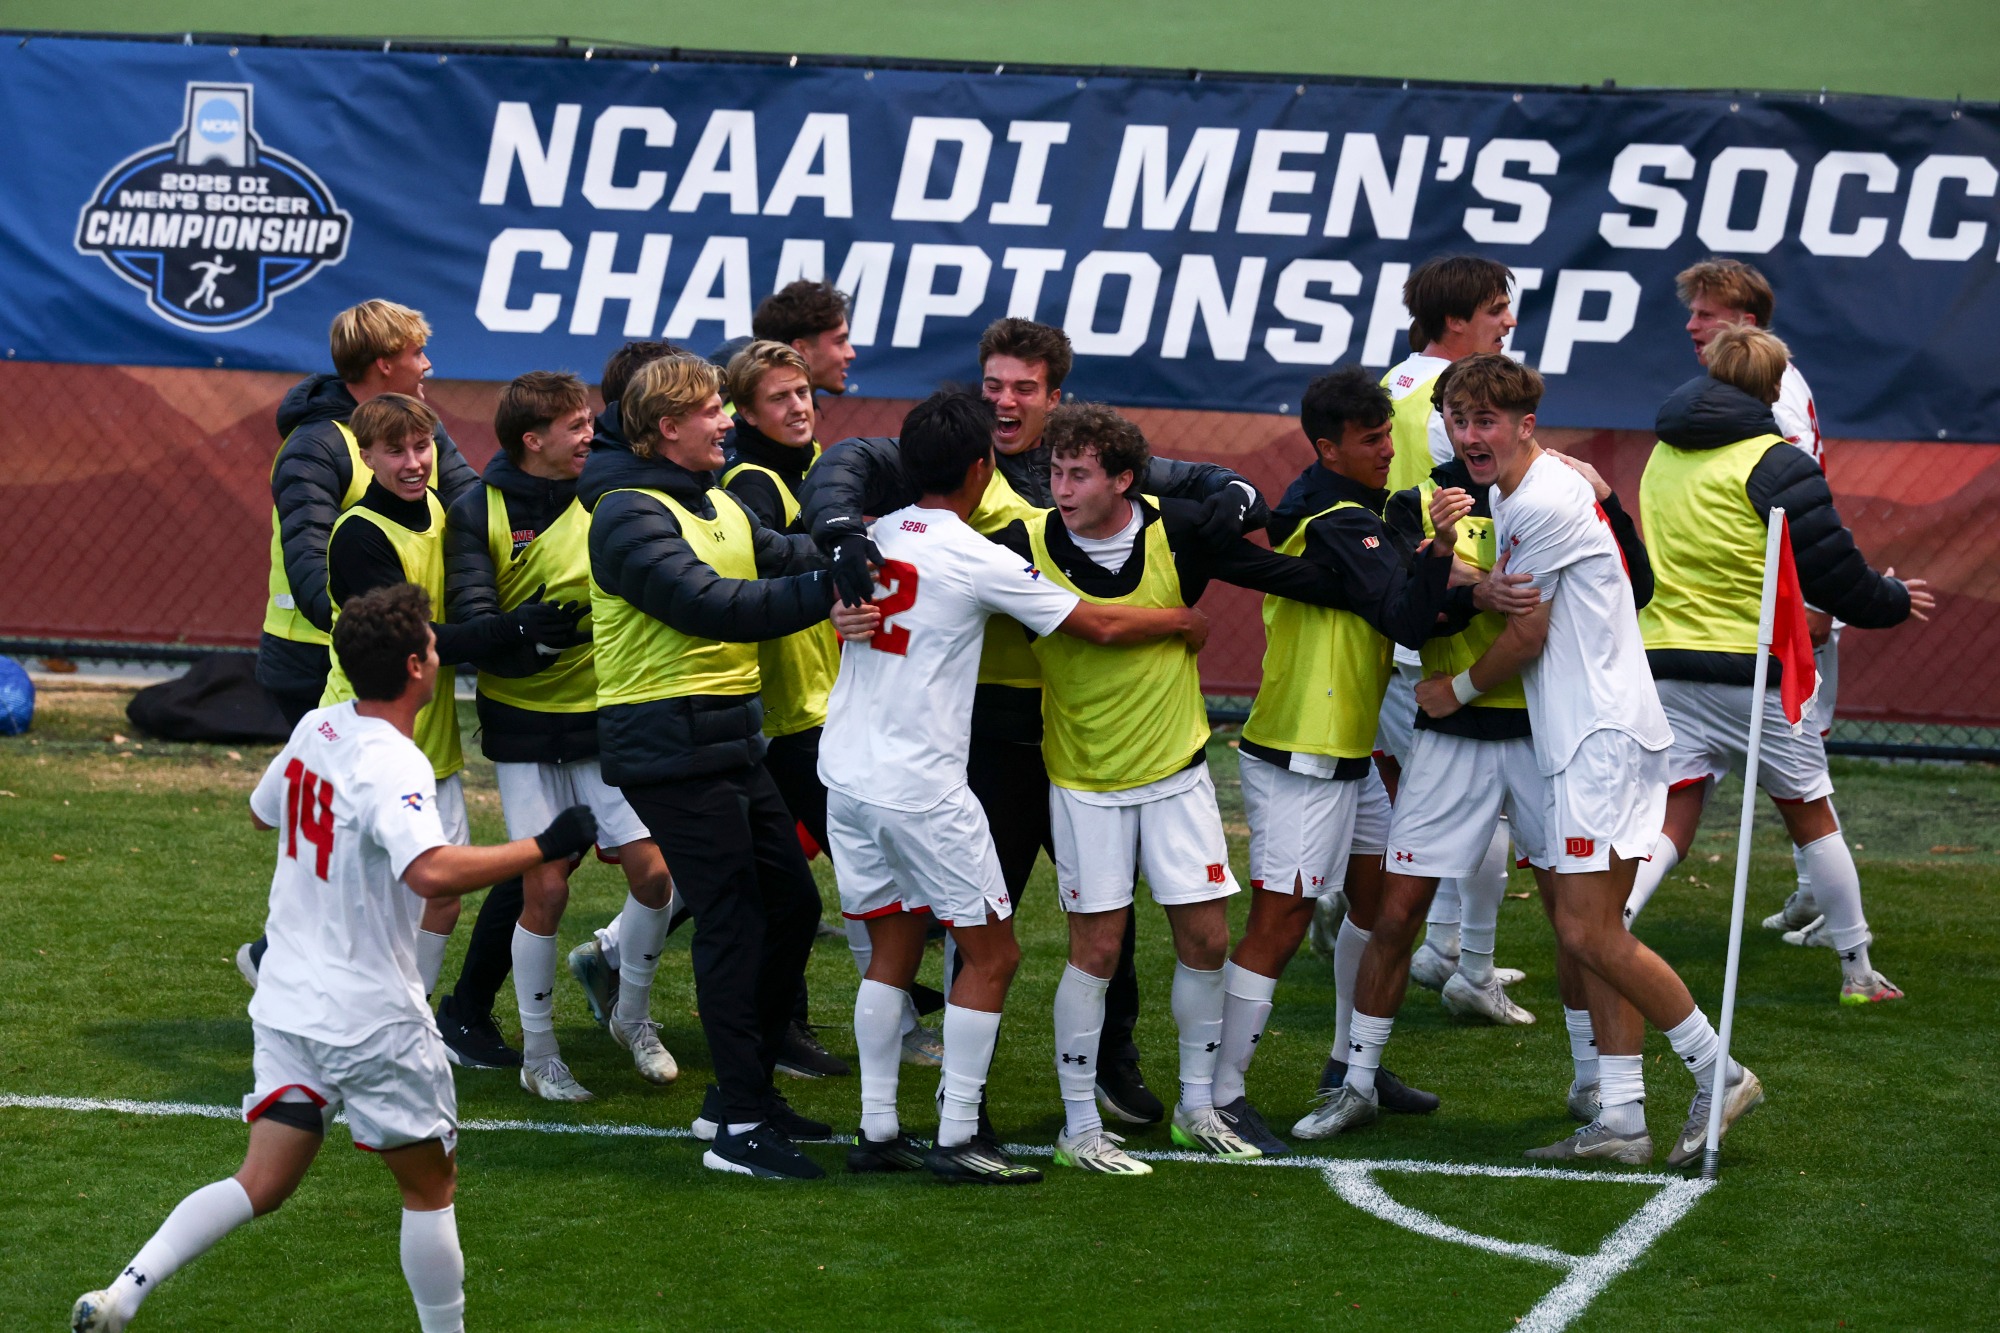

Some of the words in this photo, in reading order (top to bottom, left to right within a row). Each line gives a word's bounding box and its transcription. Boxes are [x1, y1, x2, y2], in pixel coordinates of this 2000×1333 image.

[202, 119, 239, 133] NCAA
[160, 173, 231, 192] 2025
[238, 176, 269, 194] DI
[478, 101, 853, 219] NCAA
[891, 115, 1071, 226] DI
[1598, 143, 2000, 263] SOCC
[205, 194, 309, 215] SOCCER
[85, 210, 341, 254] CHAMPIONSHIP
[870, 558, 919, 657] 2
[284, 757, 335, 882] 14
